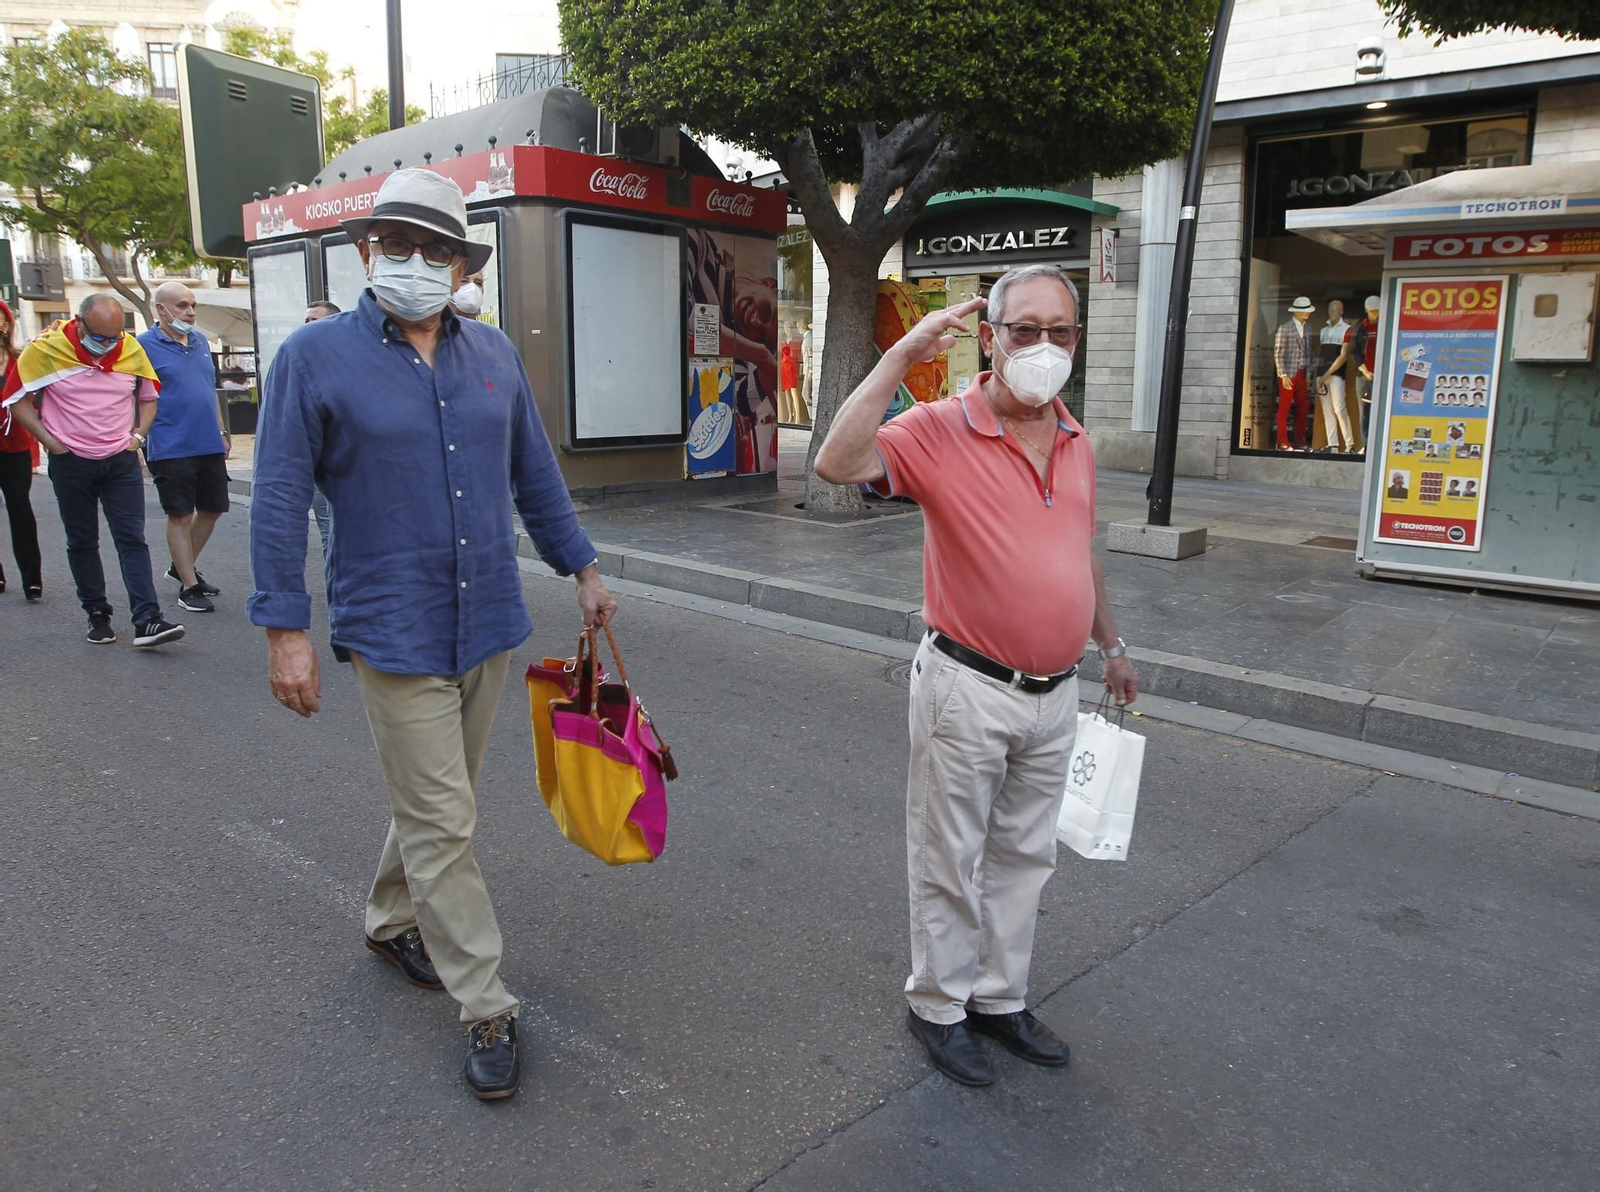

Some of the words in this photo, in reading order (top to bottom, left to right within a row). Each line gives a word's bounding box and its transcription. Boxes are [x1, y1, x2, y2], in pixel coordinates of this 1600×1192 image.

[589, 167, 649, 200] Coca-Cola
[305, 199, 341, 220] KIOSKO
[344, 191, 378, 213] PUERT
[706, 188, 756, 217] Coca-Cola
[1466, 199, 1562, 213] TECNOTRON
[915, 226, 1069, 256] J.GONZALEZ
[1409, 234, 1549, 257] FOTOS
[1405, 287, 1498, 310] FOTOS
[1401, 522, 1446, 532] TECNOTRON
